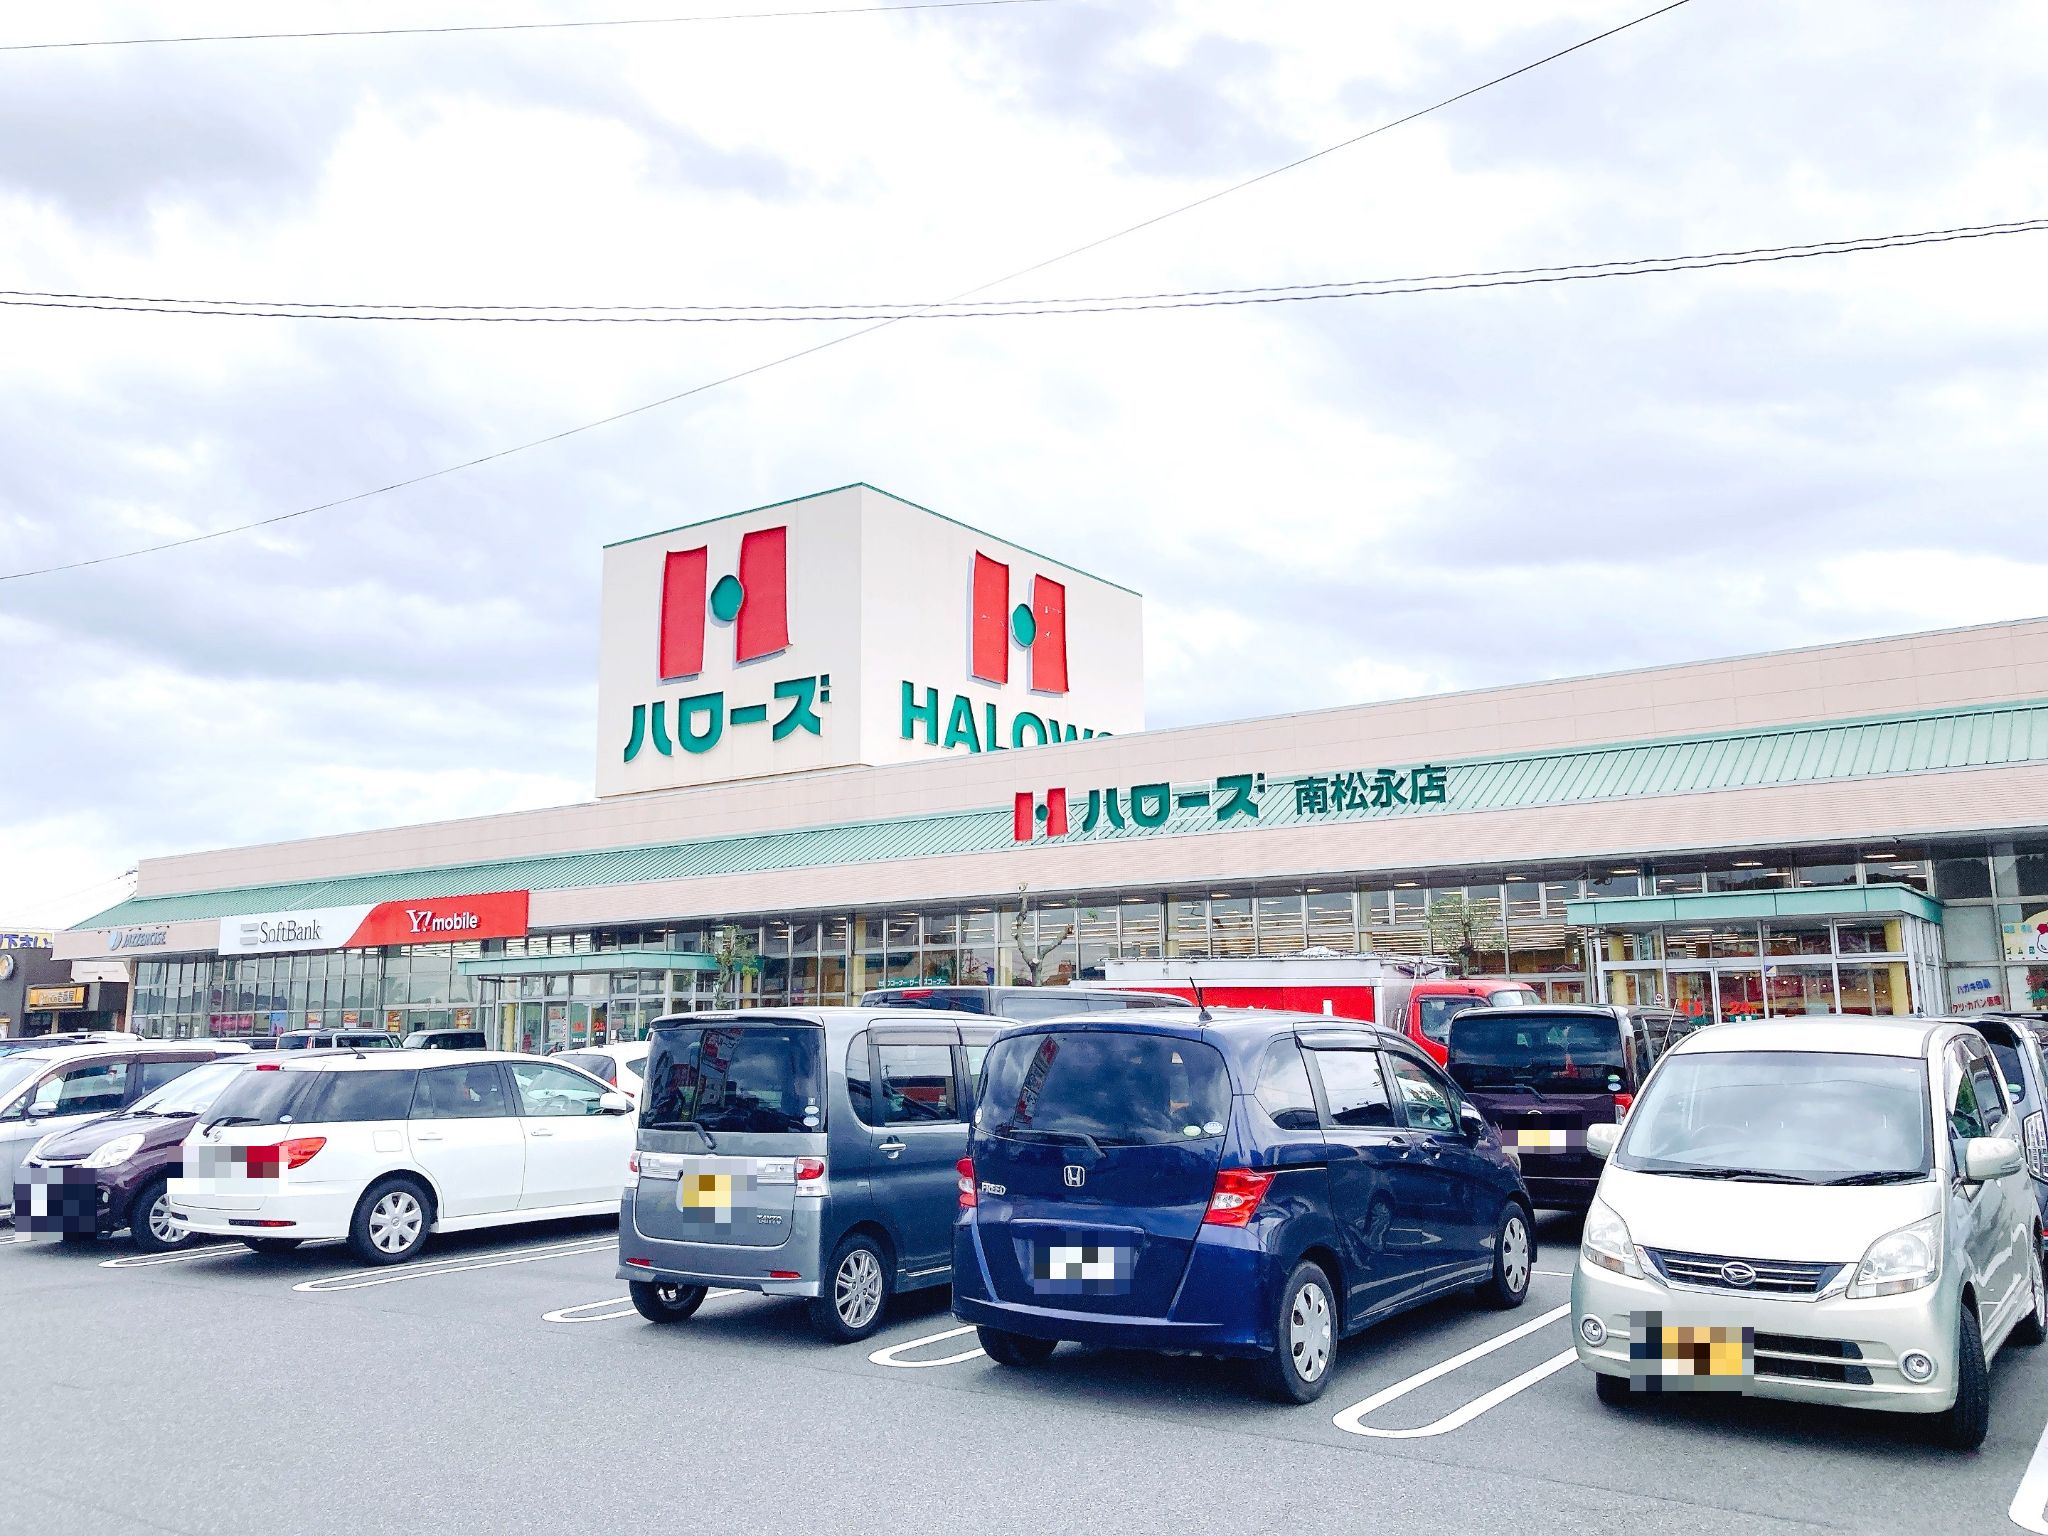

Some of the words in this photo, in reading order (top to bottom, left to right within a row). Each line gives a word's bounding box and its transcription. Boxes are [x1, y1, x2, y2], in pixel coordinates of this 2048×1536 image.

[623, 673, 831, 764] ハローズ
[900, 680, 1114, 754] HALO
[1082, 772, 1266, 834] ハローズ
[1294, 764, 1448, 816] 南松永店
[0, 933, 49, 948] 下さい
[260, 919, 321, 944] SoftBank
[981, 1182, 1006, 1195] FREED
